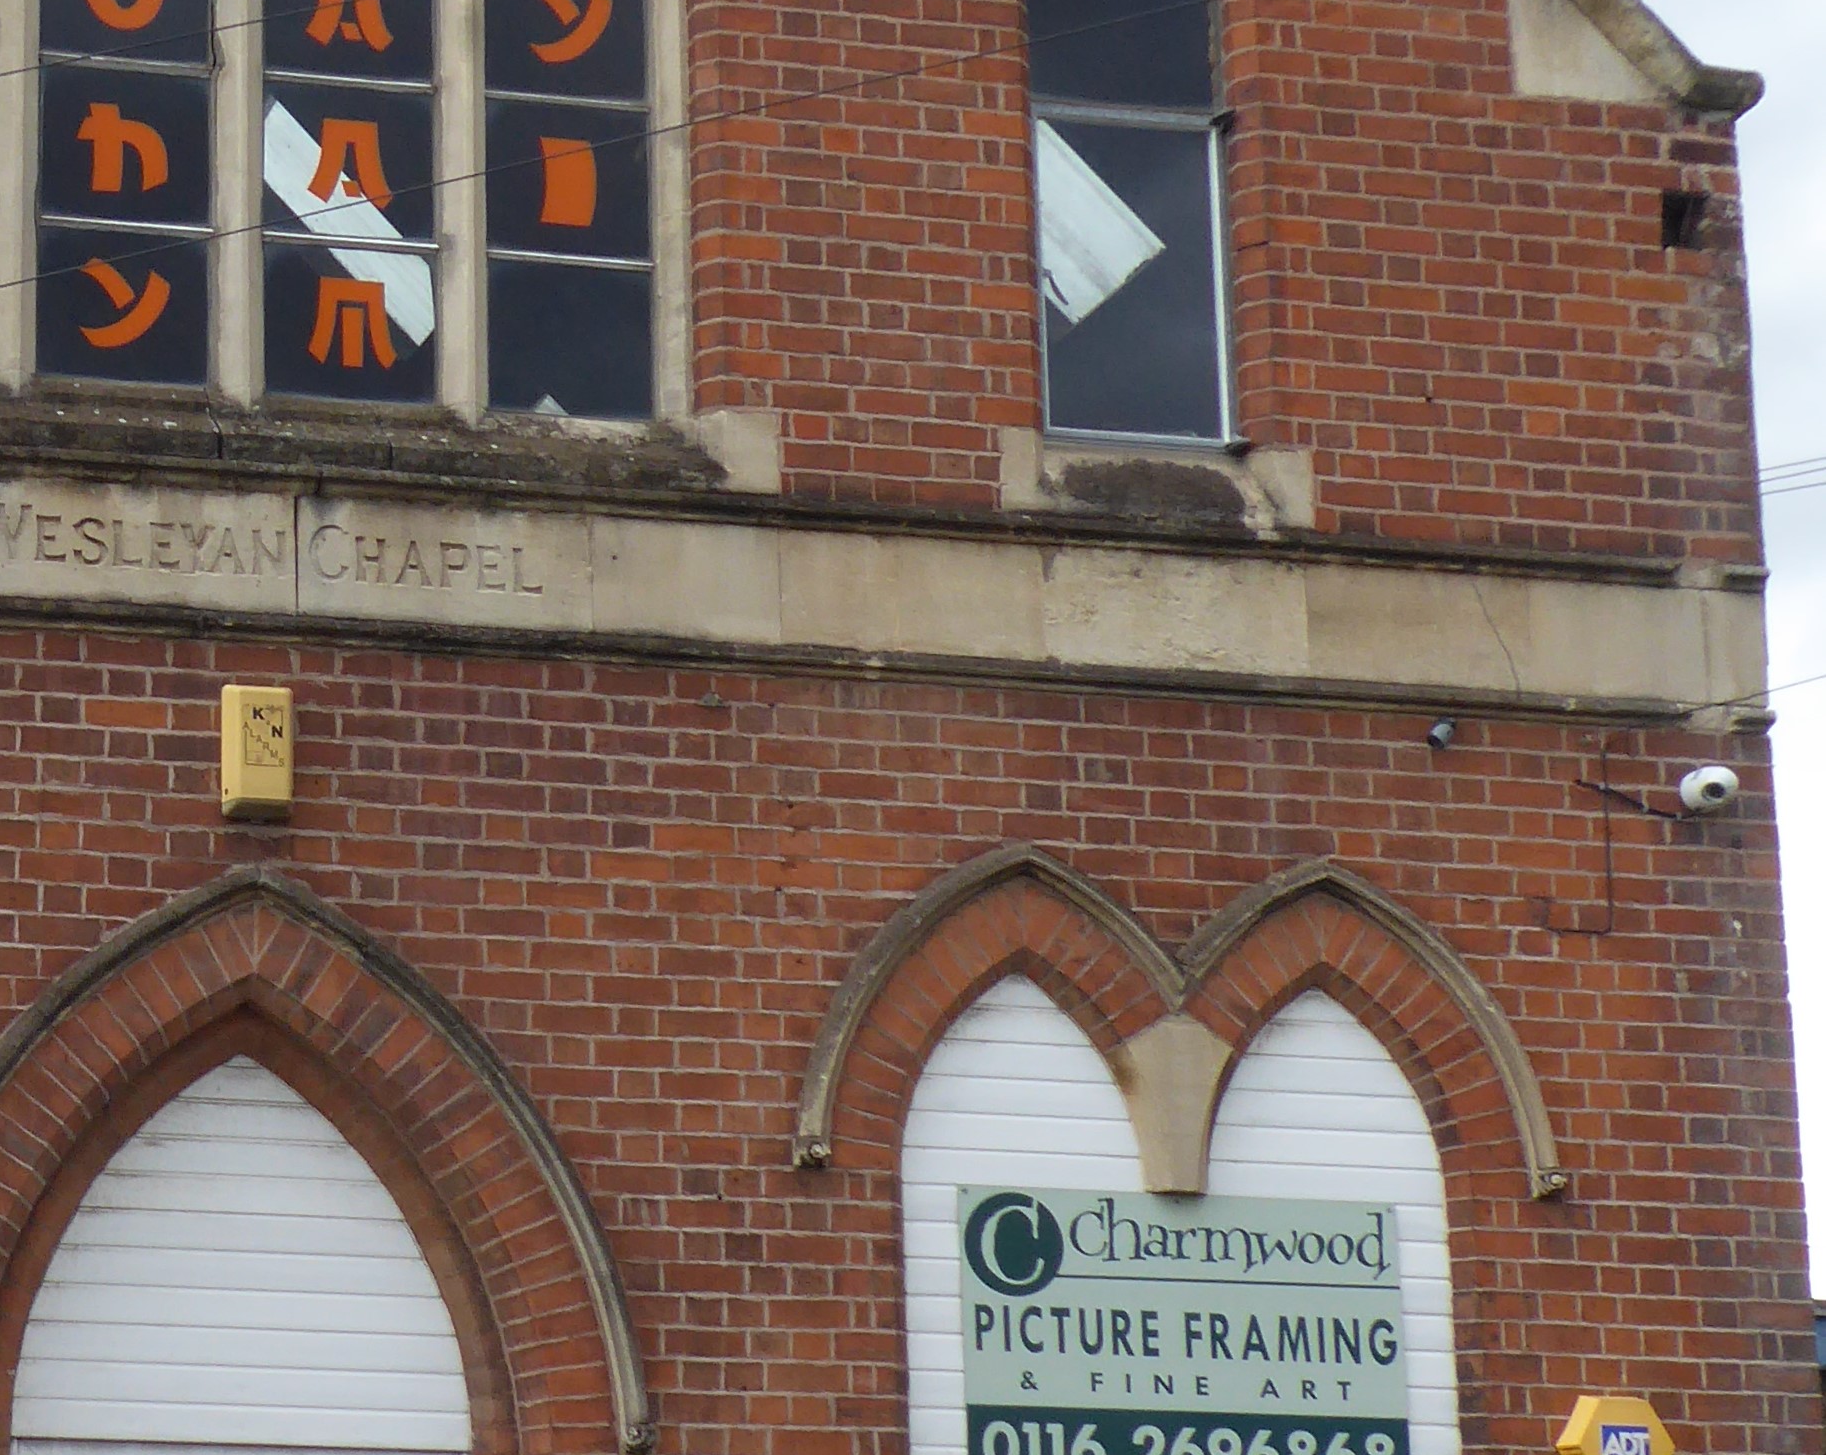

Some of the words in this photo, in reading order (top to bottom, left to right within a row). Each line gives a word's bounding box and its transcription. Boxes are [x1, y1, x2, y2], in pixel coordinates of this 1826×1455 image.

[307, 523, 544, 596] CHAPEL
[974, 1302, 1160, 1358] PICTURE
[1183, 1311, 1398, 1367] FRAMING
[1020, 1371, 1039, 1391] &
[1090, 1372, 1210, 1397] FINE
[1260, 1378, 1352, 1403] ART
